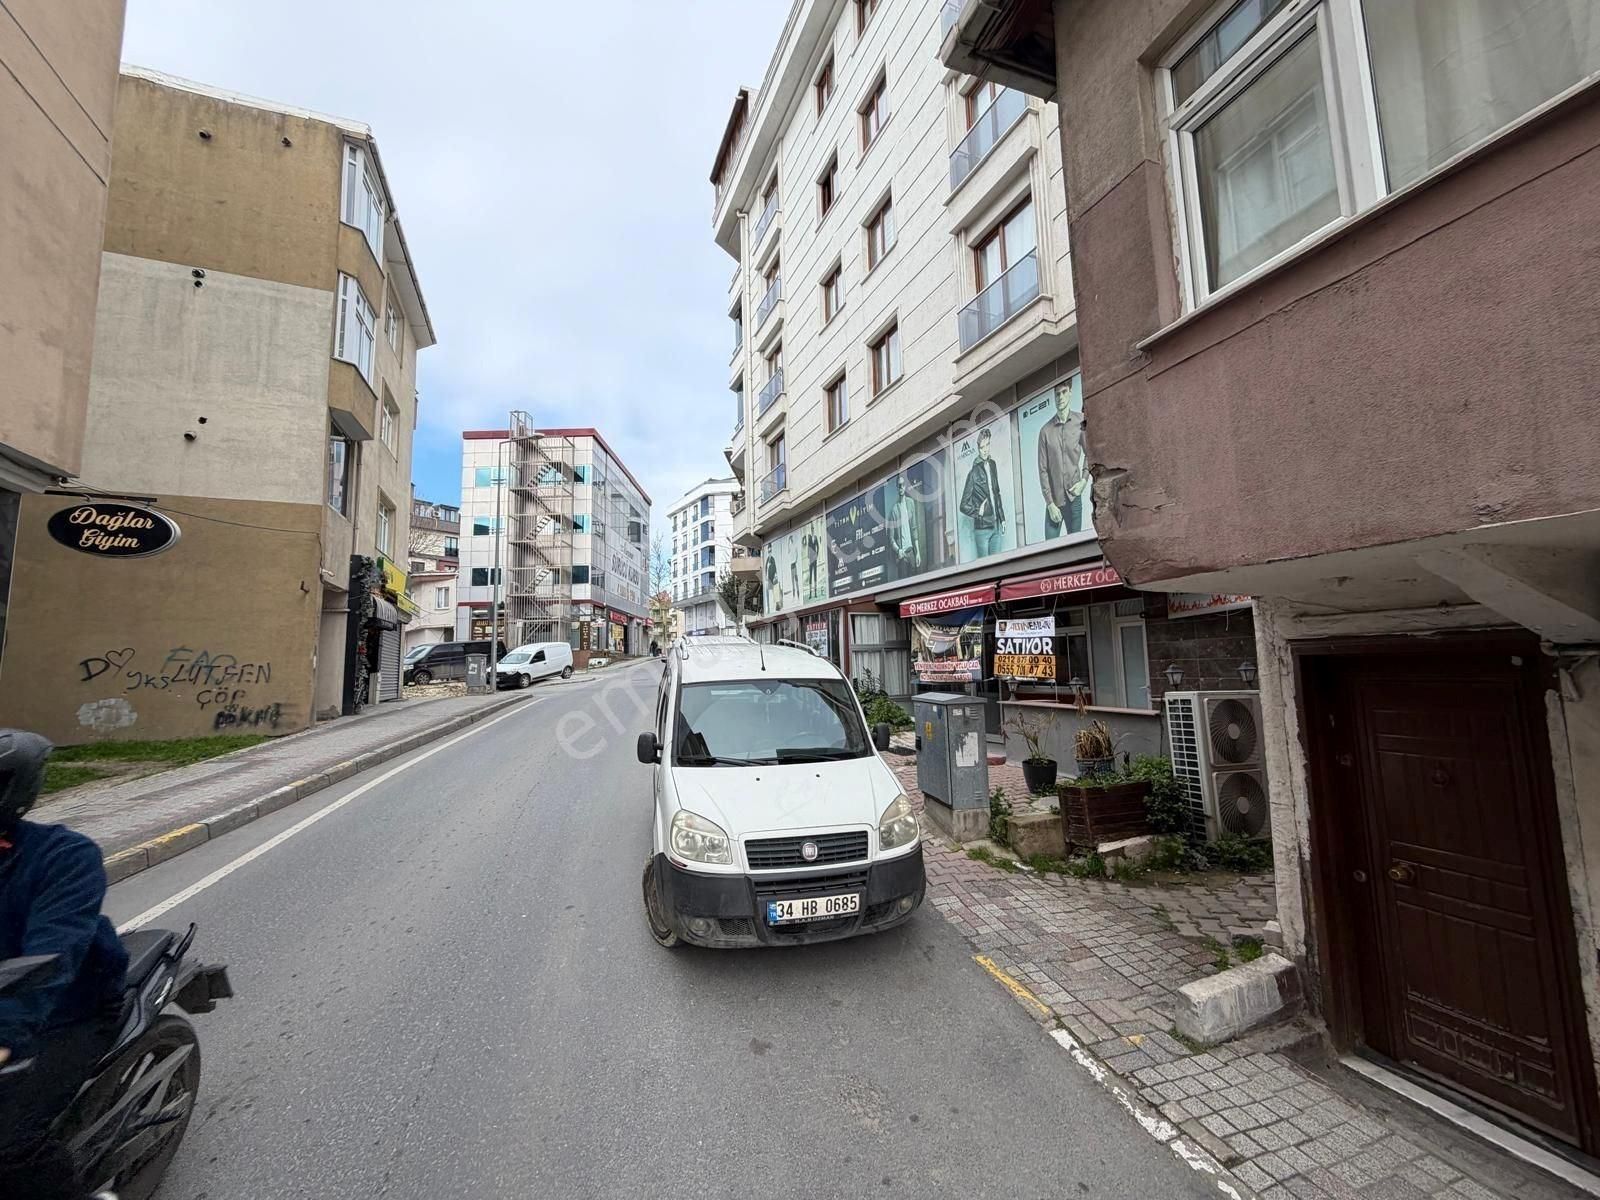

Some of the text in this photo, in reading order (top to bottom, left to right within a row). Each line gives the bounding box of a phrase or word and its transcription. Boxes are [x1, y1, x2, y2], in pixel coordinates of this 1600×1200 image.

[69, 506, 155, 531] Dağlar
[79, 529, 140, 550] Giyim
[1053, 572, 1092, 591] MERKEZ
[916, 601, 938, 613] MERKEZ
[938, 594, 969, 610] OCAKBAŞI
[997, 637, 1053, 655] SATIYOR
[998, 655, 1015, 664] 0212
[1028, 655, 1039, 665] 00
[1042, 656, 1052, 665] 40
[997, 664, 1014, 676] 0555
[1028, 665, 1039, 676] 47
[1041, 665, 1054, 677] 43
[777, 896, 857, 918] 34 HB 0685
